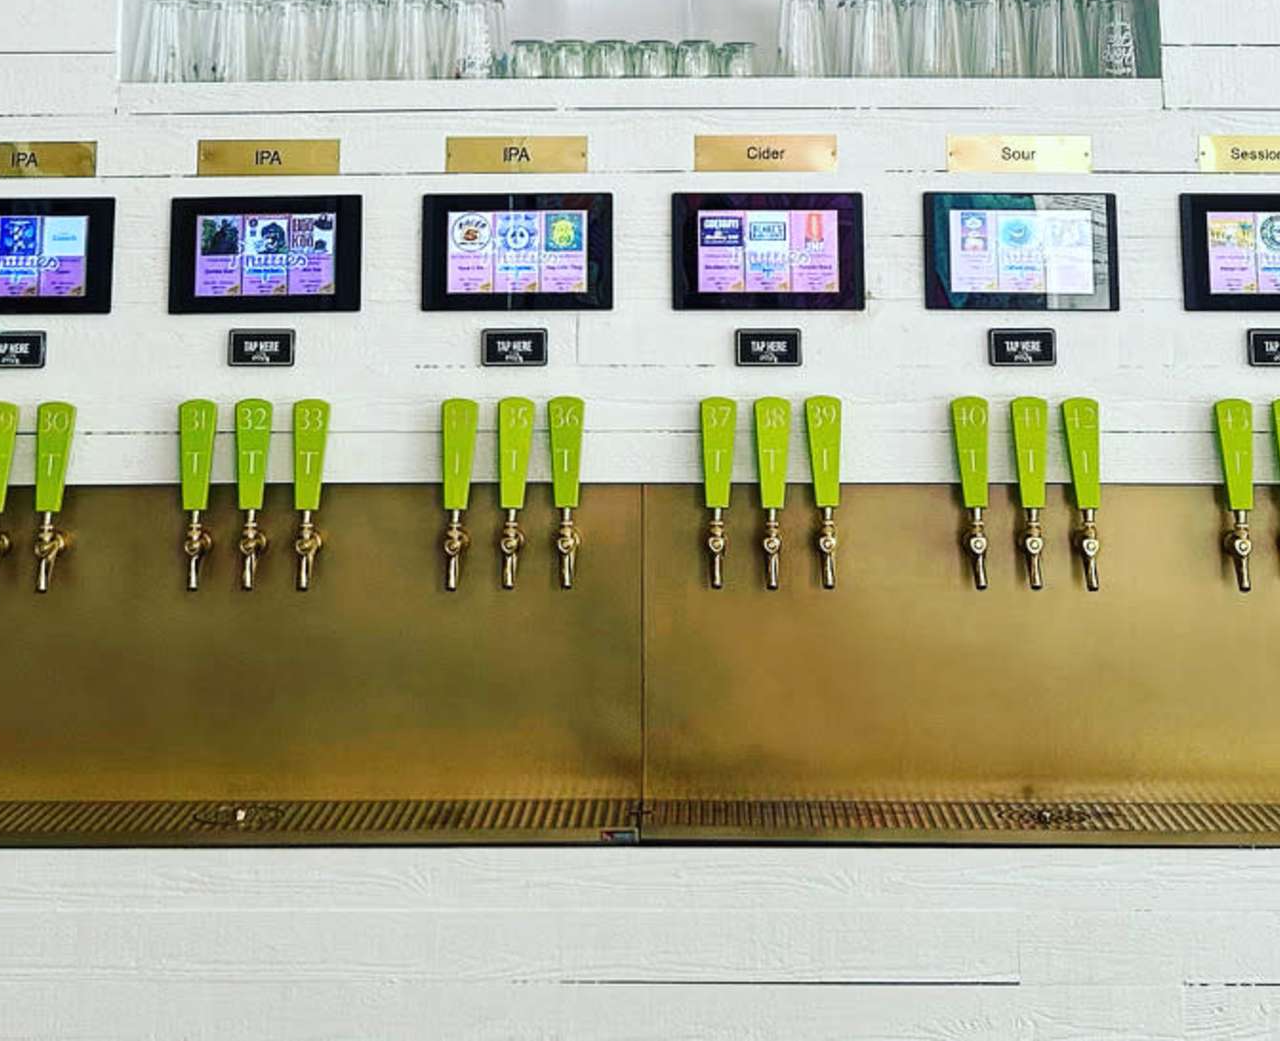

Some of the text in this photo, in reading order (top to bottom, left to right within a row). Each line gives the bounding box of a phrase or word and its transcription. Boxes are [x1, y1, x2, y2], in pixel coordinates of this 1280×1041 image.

[11, 152, 38, 168] IPA
[255, 150, 282, 165] IPA
[503, 147, 530, 162] IPA
[747, 146, 785, 160] Cider
[1001, 147, 1036, 160] Sour
[10, 344, 30, 354] HERE
[244, 341, 280, 351] TAP HERE
[751, 341, 787, 351] TAP HERE
[1264, 341, 1279, 351] TAP
[42, 410, 69, 432] 30
[241, 408, 267, 429] 32
[299, 408, 322, 430] 33
[552, 406, 579, 429] 36
[243, 451, 263, 474] T
